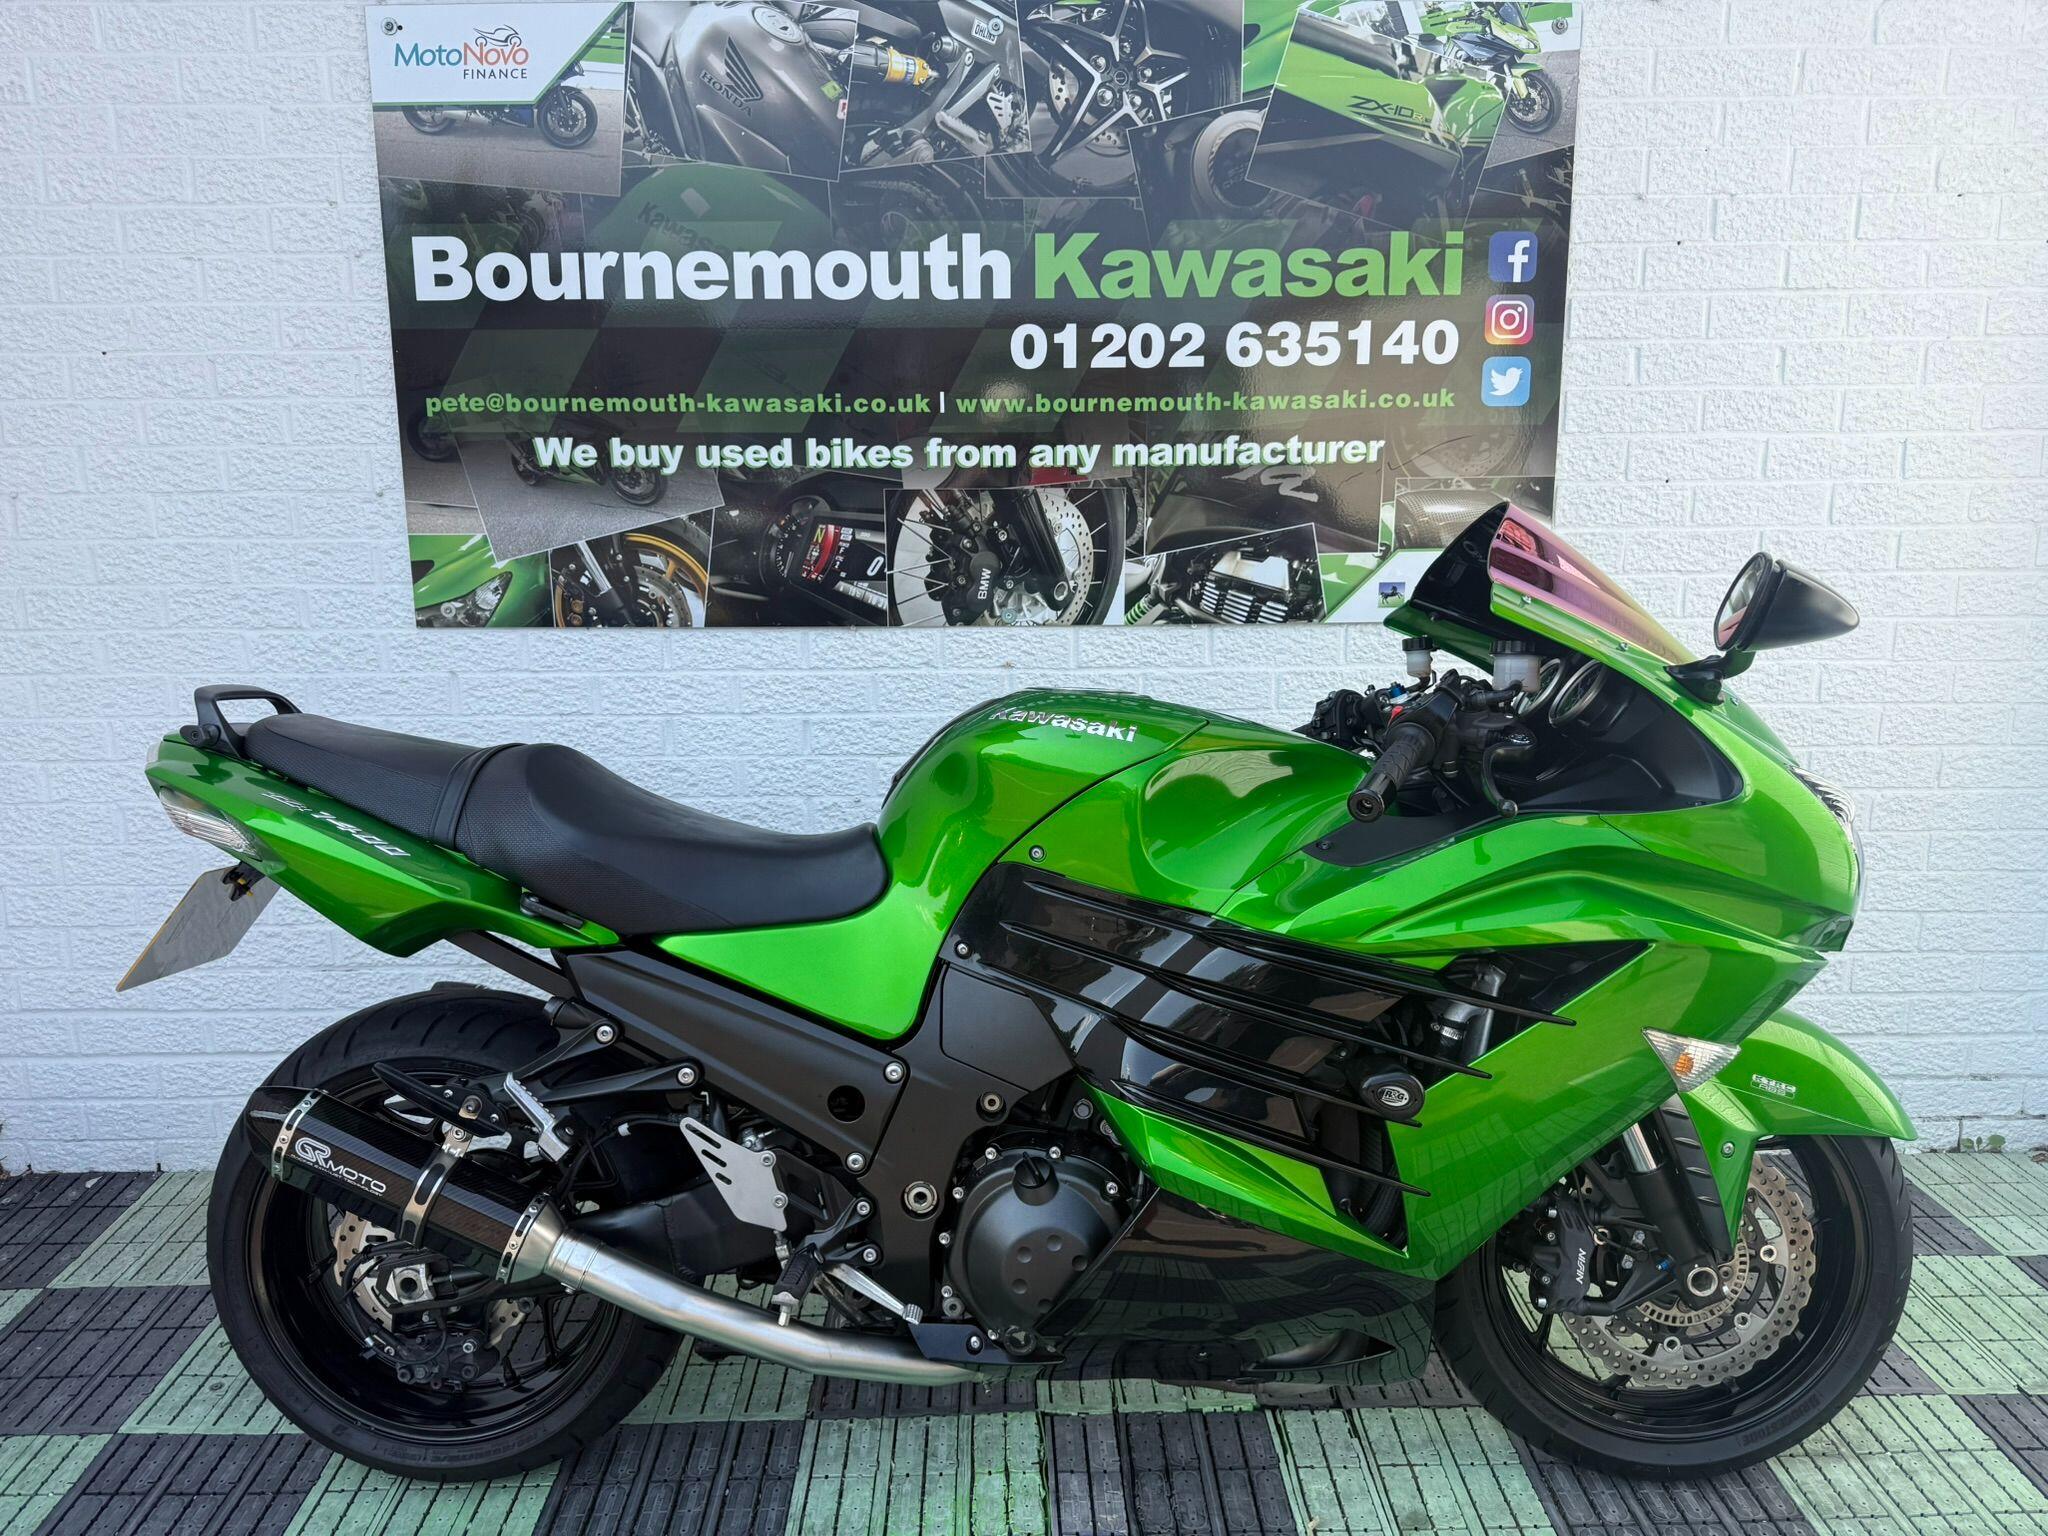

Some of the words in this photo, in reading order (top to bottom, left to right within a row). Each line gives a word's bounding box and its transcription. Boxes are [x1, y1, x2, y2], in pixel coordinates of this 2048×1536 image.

[394, 42, 529, 66] MotoNovo
[463, 68, 528, 79] FINANCE
[699, 70, 753, 118] HONDA
[410, 232, 1012, 302] Bournemouth
[1034, 230, 1464, 300] Kawasaki
[1009, 322, 1206, 370] 01202
[1225, 318, 1460, 368] 635140
[426, 393, 931, 416] pete@bournemouth-kawasaki.co.uk
[956, 389, 1456, 413] www.bournemouth-kawasaki.co.uk
[533, 436, 598, 468] We
[610, 437, 683, 475] buy
[697, 437, 793, 468] used
[806, 437, 914, 468] bikes
[925, 437, 1017, 468] from
[1029, 440, 1101, 475] any
[1112, 434, 1387, 468] manufacturer
[977, 567, 992, 600] BMW
[988, 706, 1139, 743] Kawasaki
[1575, 1247, 1587, 1285] NISSIN
